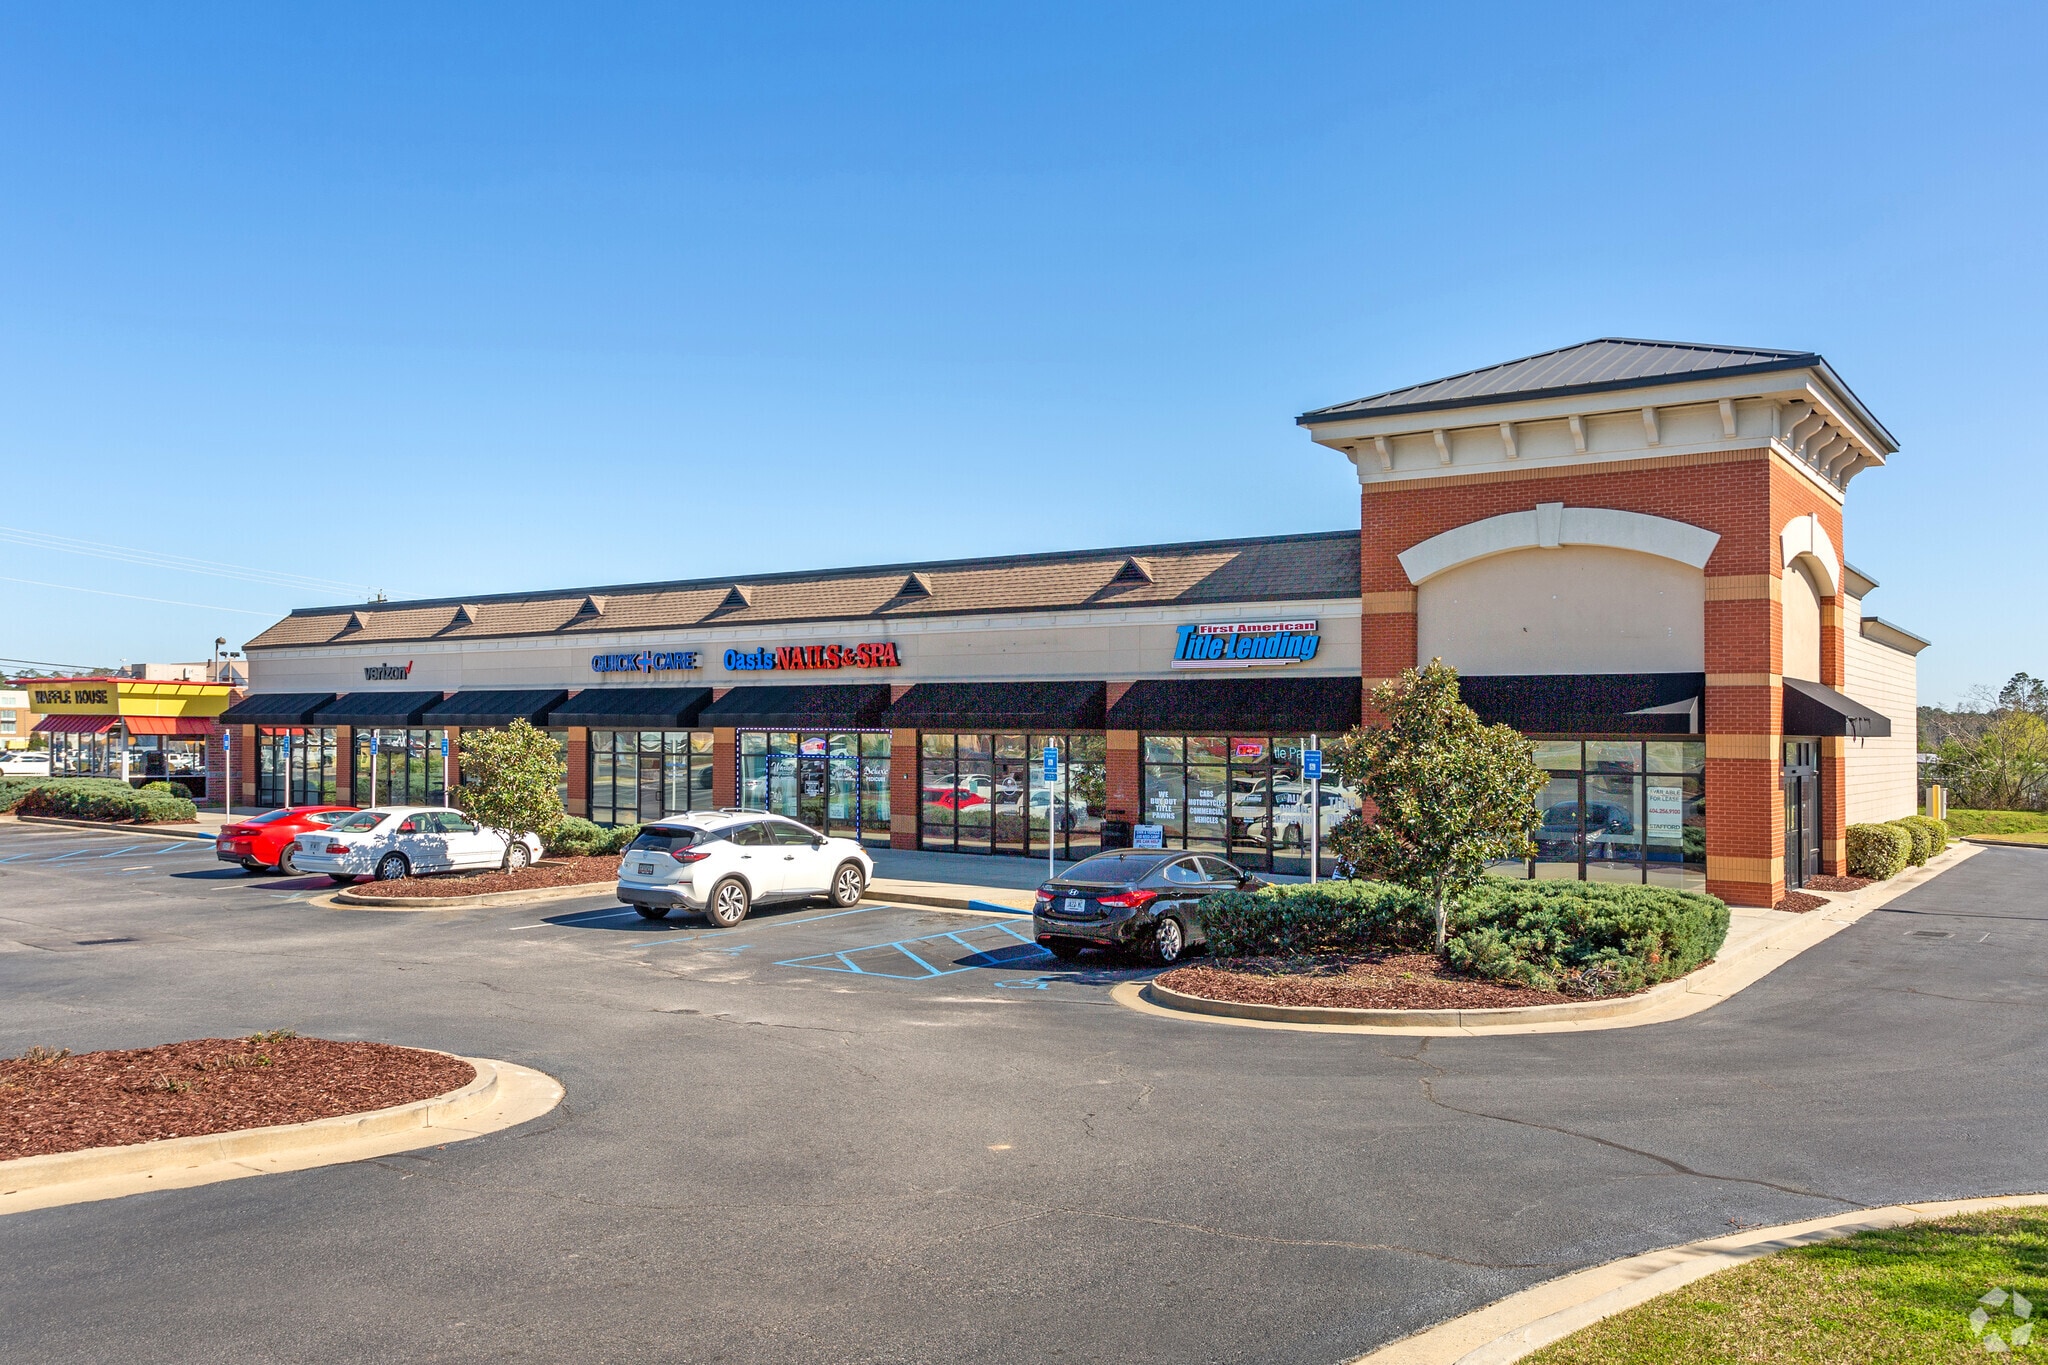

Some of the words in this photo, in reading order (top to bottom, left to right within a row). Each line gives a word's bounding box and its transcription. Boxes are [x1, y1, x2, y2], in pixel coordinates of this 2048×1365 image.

[1200, 624, 1233, 633] First
[1237, 622, 1315, 632] American
[1174, 625, 1225, 660] Title
[1225, 631, 1320, 661] Lending
[723, 647, 775, 671] Oasis
[775, 644, 842, 670] NAILS
[856, 641, 900, 669] SPA
[363, 662, 408, 681] verizon
[34, 690, 71, 704] WAFFLE
[74, 690, 108, 704] HOUSE
[1188, 798, 1226, 807] MOTORCYCLES
[1328, 797, 1355, 810] TITLE
[1152, 812, 1175, 820] PAWNS
[1189, 807, 1224, 815] COMMERCIAL
[1195, 816, 1218, 824] VEHICLES
